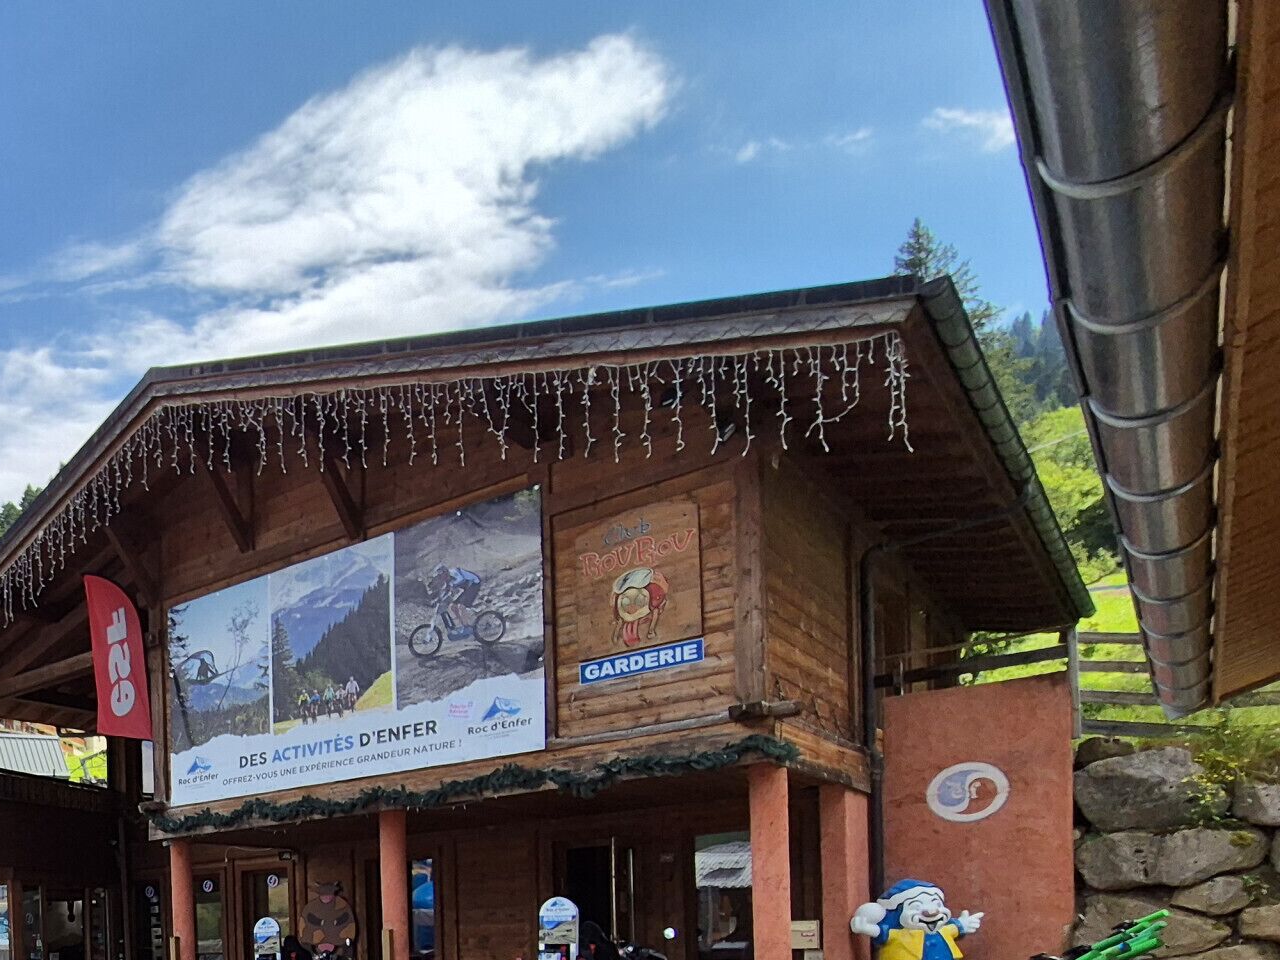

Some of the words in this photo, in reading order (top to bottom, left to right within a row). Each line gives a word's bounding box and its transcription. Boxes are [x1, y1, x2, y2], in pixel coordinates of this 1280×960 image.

[584, 643, 698, 680] GARDERIE
[239, 752, 268, 769] DES
[271, 733, 355, 763] ACTIVITÉS
[359, 719, 438, 747] D'ENFER
[467, 725, 489, 735] Roc
[491, 717, 533, 731] d'Enfer
[222, 770, 278, 786] OFFREZ-VOUS
[280, 765, 297, 777] UNE
[300, 757, 355, 773] EXPÉRIENCE
[356, 748, 411, 764] GRANDEUR
[413, 739, 456, 756] NATURE
[178, 777, 191, 786] Roc
